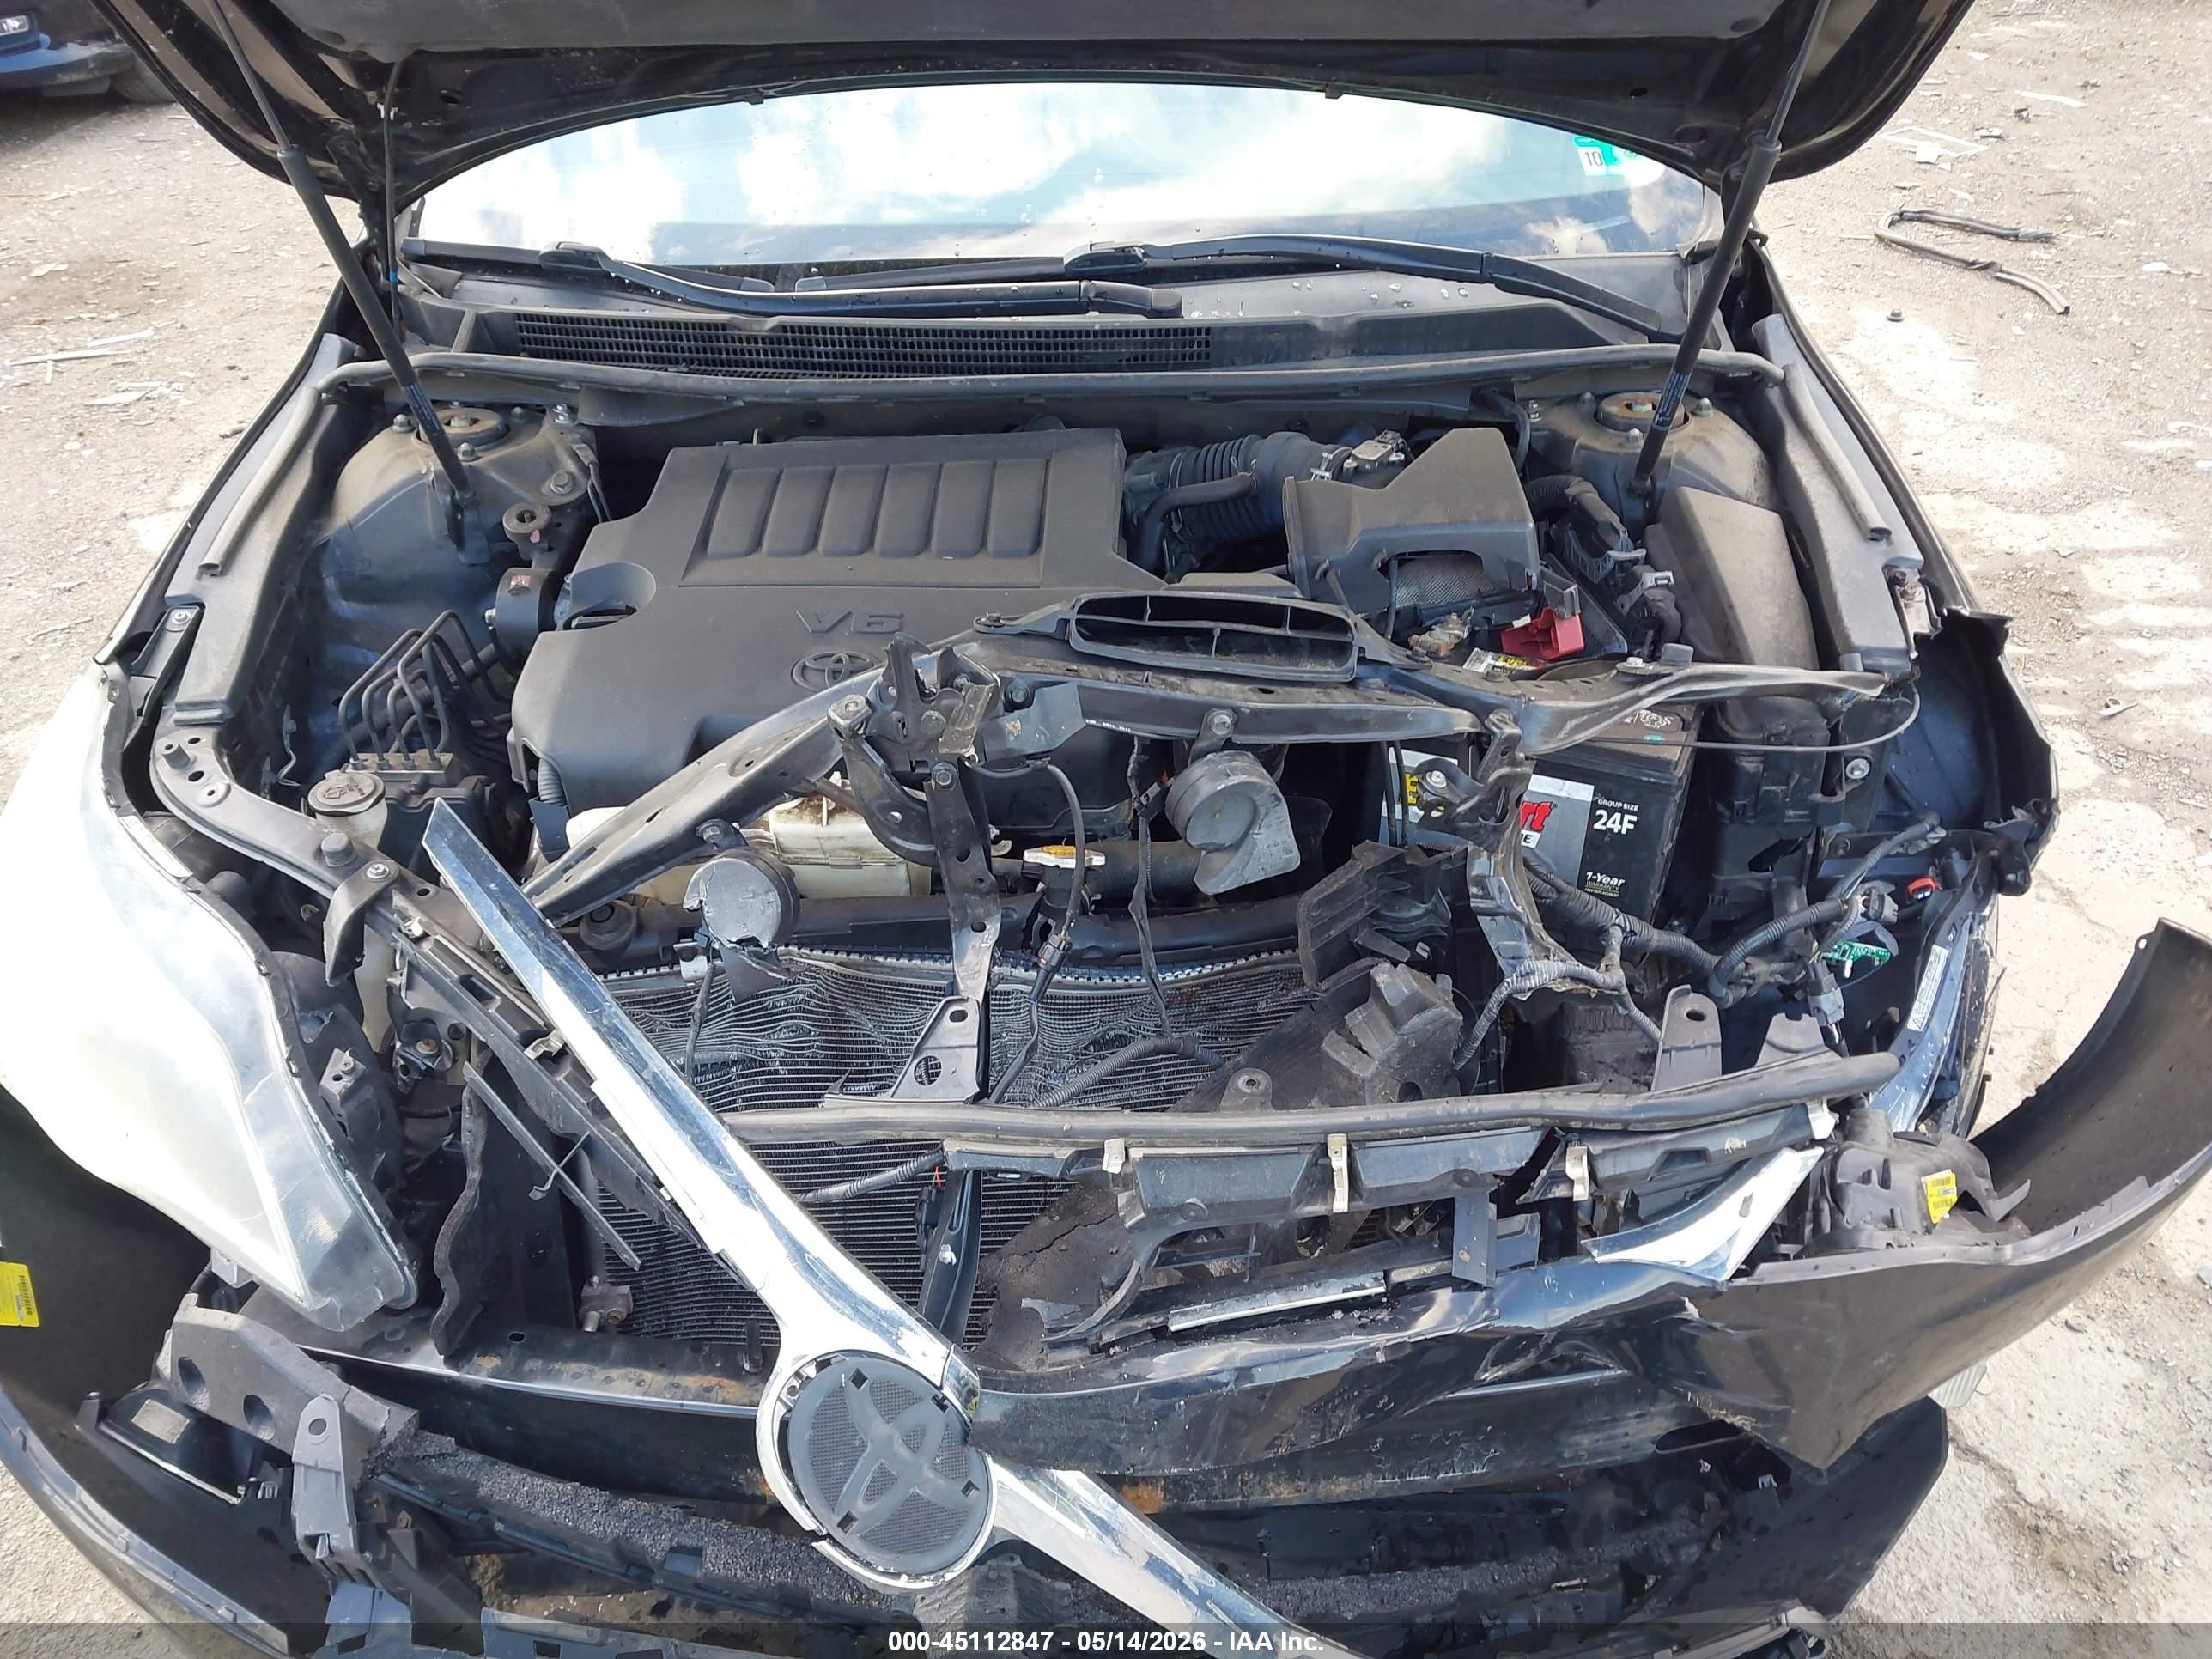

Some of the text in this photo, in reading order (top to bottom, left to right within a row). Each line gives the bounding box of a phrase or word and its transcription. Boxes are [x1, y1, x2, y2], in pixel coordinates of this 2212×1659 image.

[1584, 151, 1603, 167] 10
[796, 611, 904, 634] V6
[1597, 799, 1639, 811] GROUP SIZE
[1593, 808, 1638, 835] 24F
[1586, 872, 1626, 886] 1-Year
[1586, 881, 1620, 891] WARRANTY
